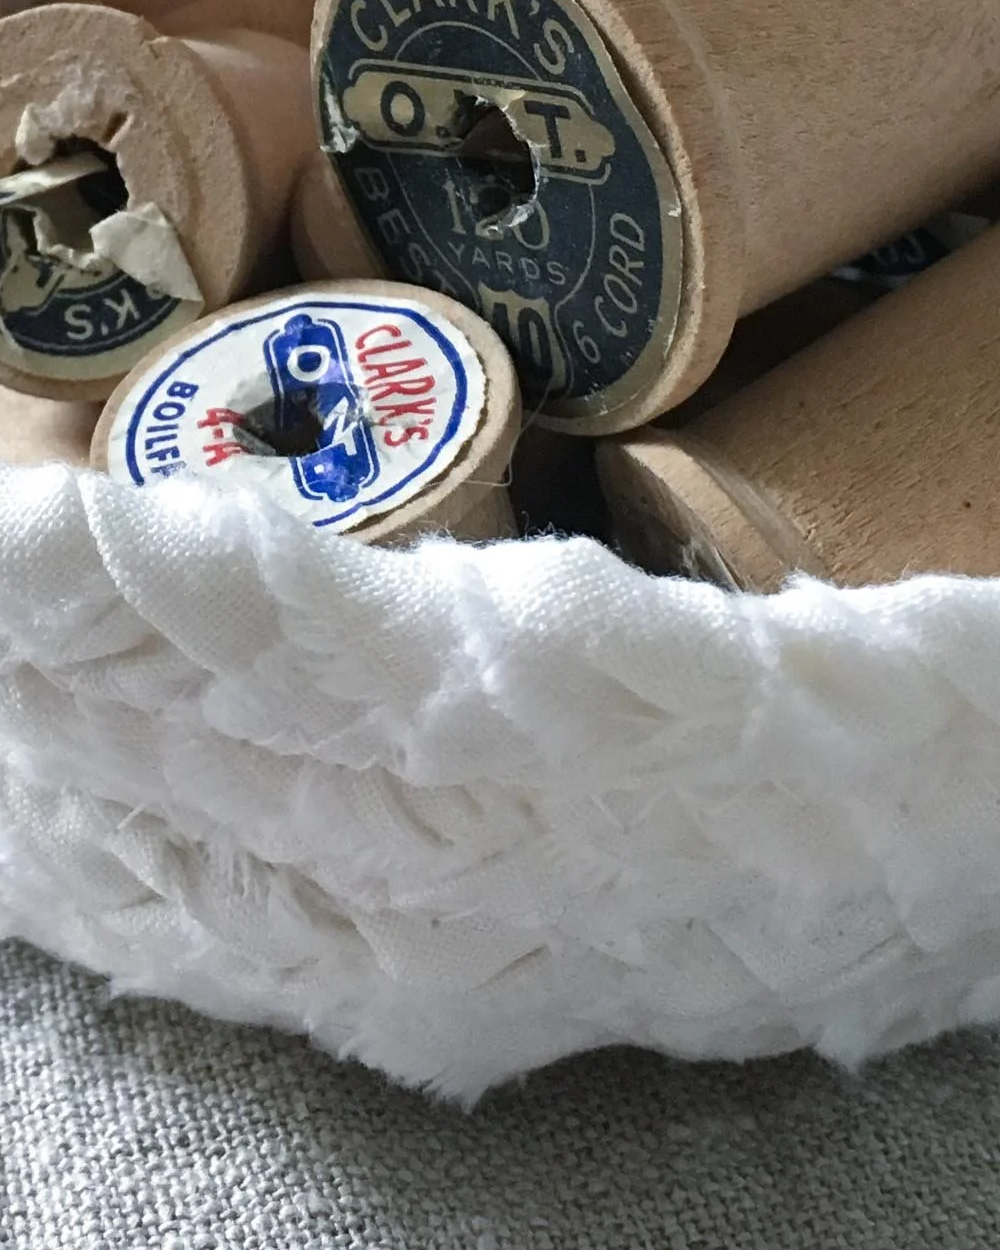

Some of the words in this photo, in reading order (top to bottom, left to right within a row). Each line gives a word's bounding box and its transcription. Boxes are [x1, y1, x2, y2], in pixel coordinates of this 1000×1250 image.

[447, 240, 567, 286] YARDS
[572, 319, 601, 364] 6
[594, 212, 645, 338] CORD
[354, 323, 438, 448] CLARK'S
